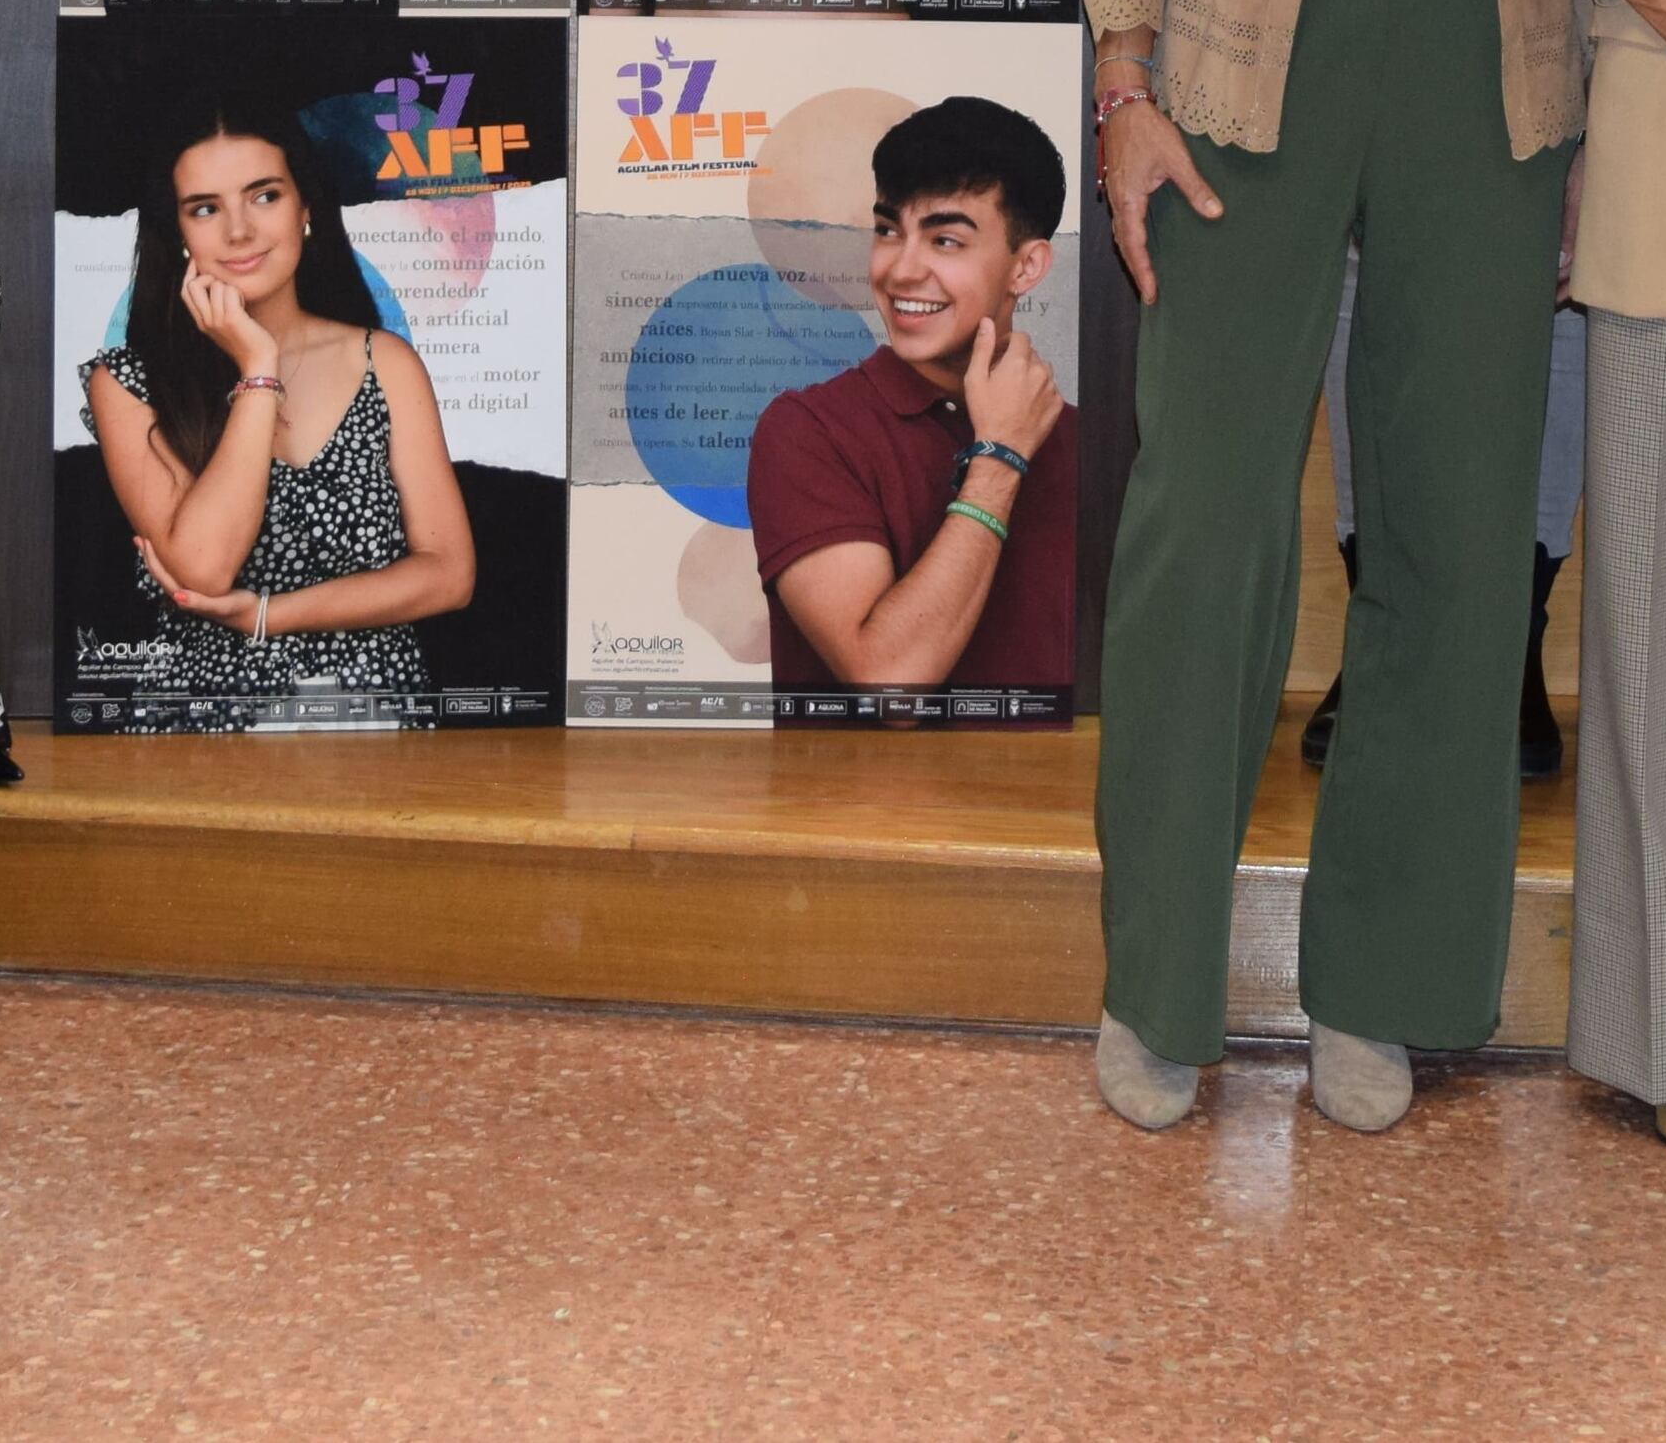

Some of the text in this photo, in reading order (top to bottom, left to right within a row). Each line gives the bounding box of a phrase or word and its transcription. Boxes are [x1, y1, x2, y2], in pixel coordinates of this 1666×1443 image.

[616, 60, 718, 117] 37
[374, 73, 475, 132] 37
[618, 111, 773, 163] AFF
[375, 124, 530, 181] AFF
[617, 159, 759, 175] AGUILAR FILM FESTIVAL
[346, 224, 444, 245] onectando
[450, 224, 467, 244] el
[412, 252, 546, 272] comunicación
[712, 268, 770, 283] nueva
[774, 269, 808, 283] voz
[374, 283, 489, 301] mprendedor
[605, 290, 673, 310] sincera
[425, 308, 509, 327] artificial
[417, 338, 481, 355] rimera
[483, 368, 542, 383] motor
[468, 392, 529, 414] digital
[609, 404, 660, 422] antes
[664, 402, 687, 421] de
